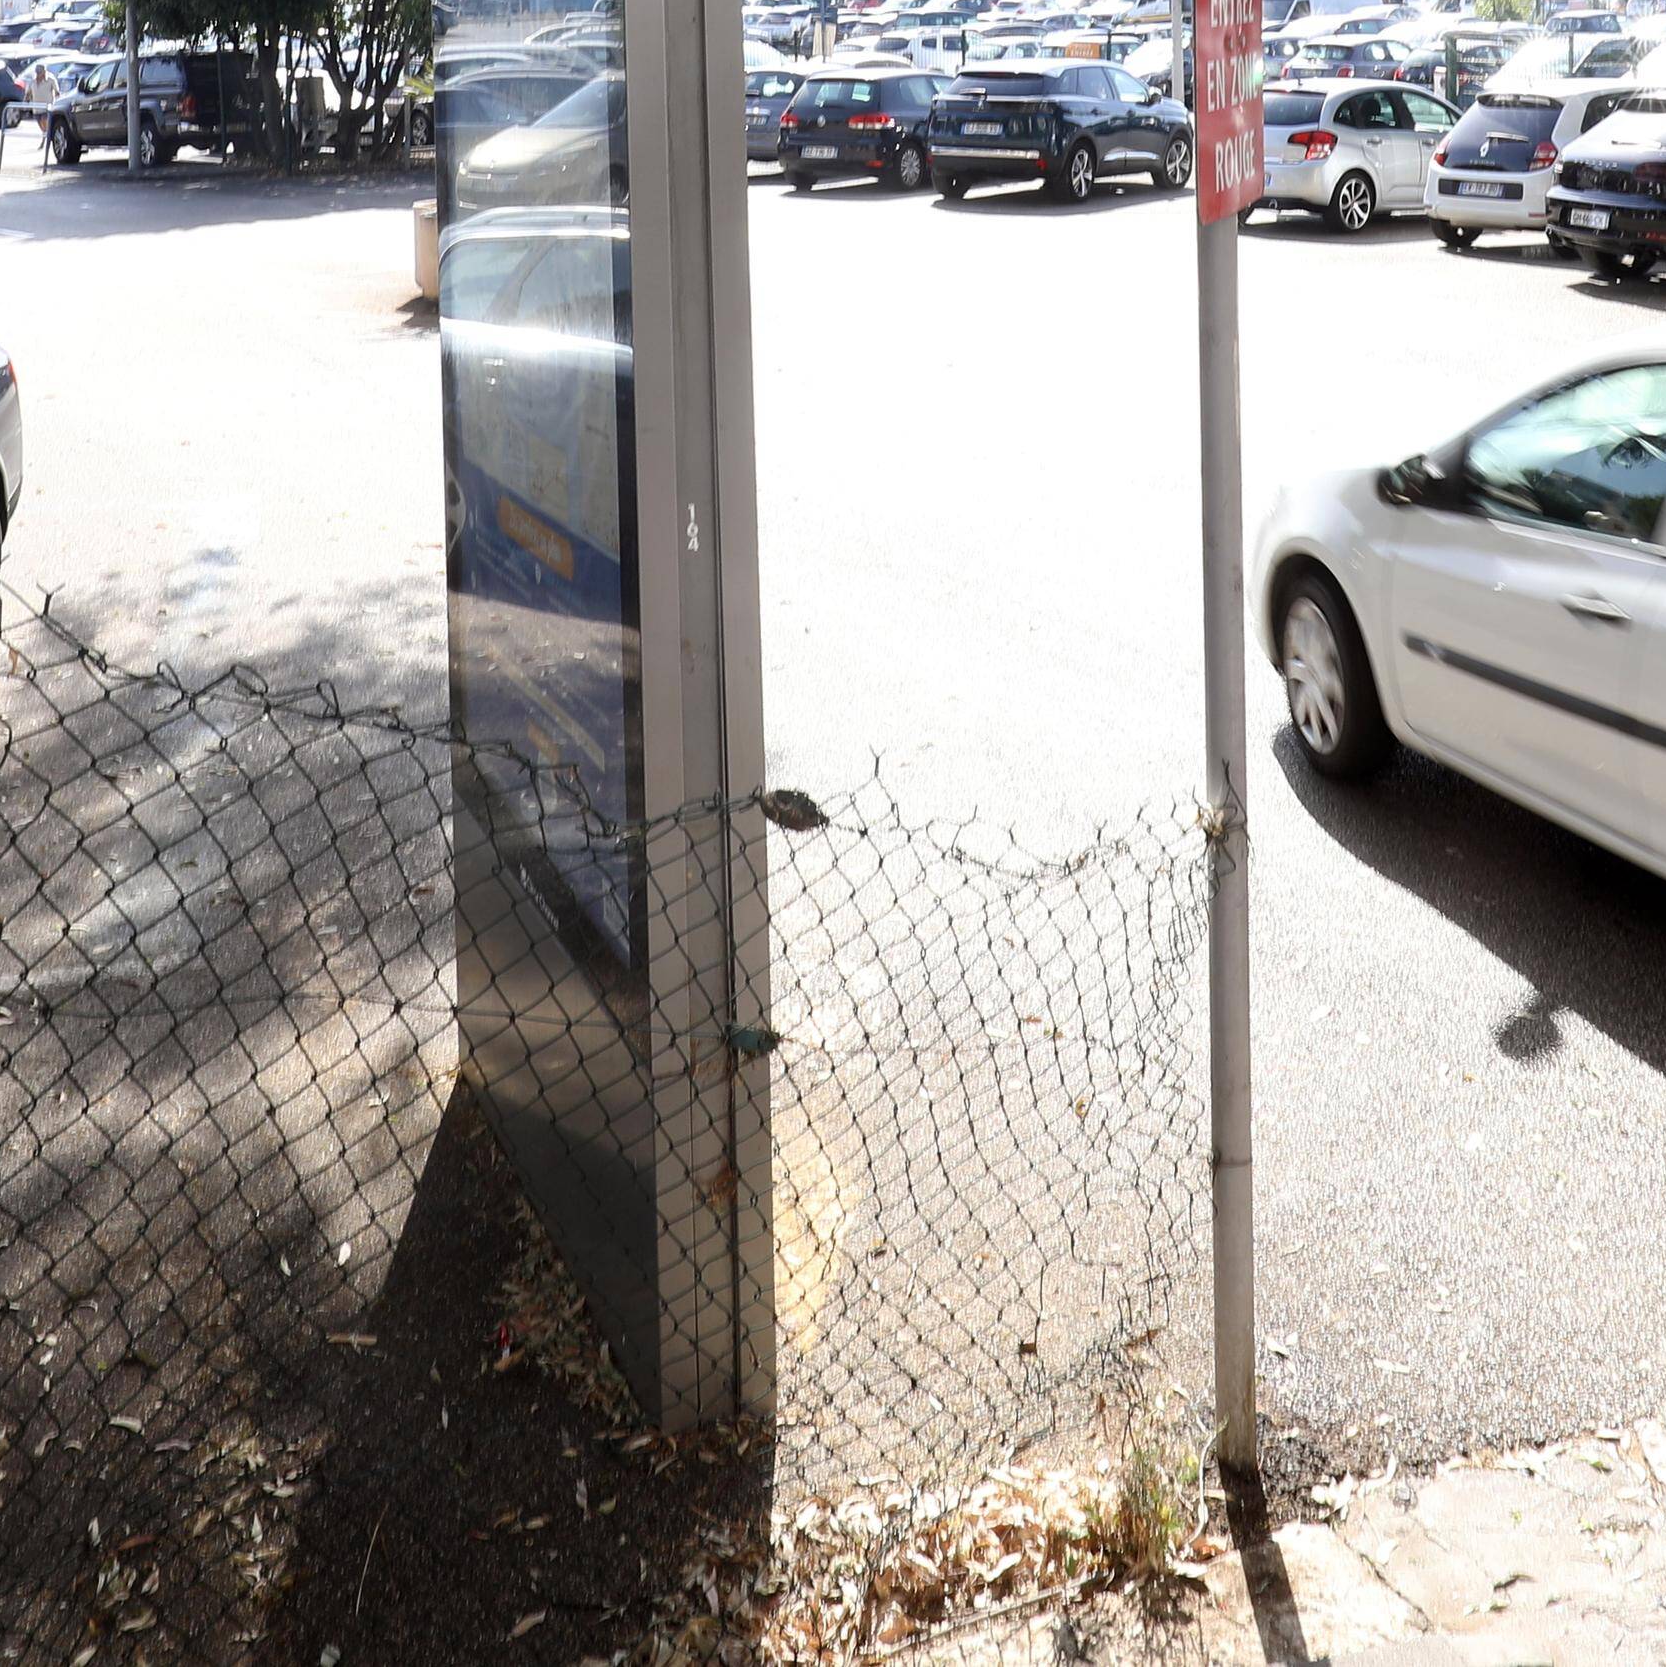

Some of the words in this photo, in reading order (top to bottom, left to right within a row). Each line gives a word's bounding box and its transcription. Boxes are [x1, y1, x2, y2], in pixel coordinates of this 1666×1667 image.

[1207, 60, 1227, 112] EN
[1231, 53, 1259, 106] ZONE
[1215, 130, 1256, 192] ROUGE
